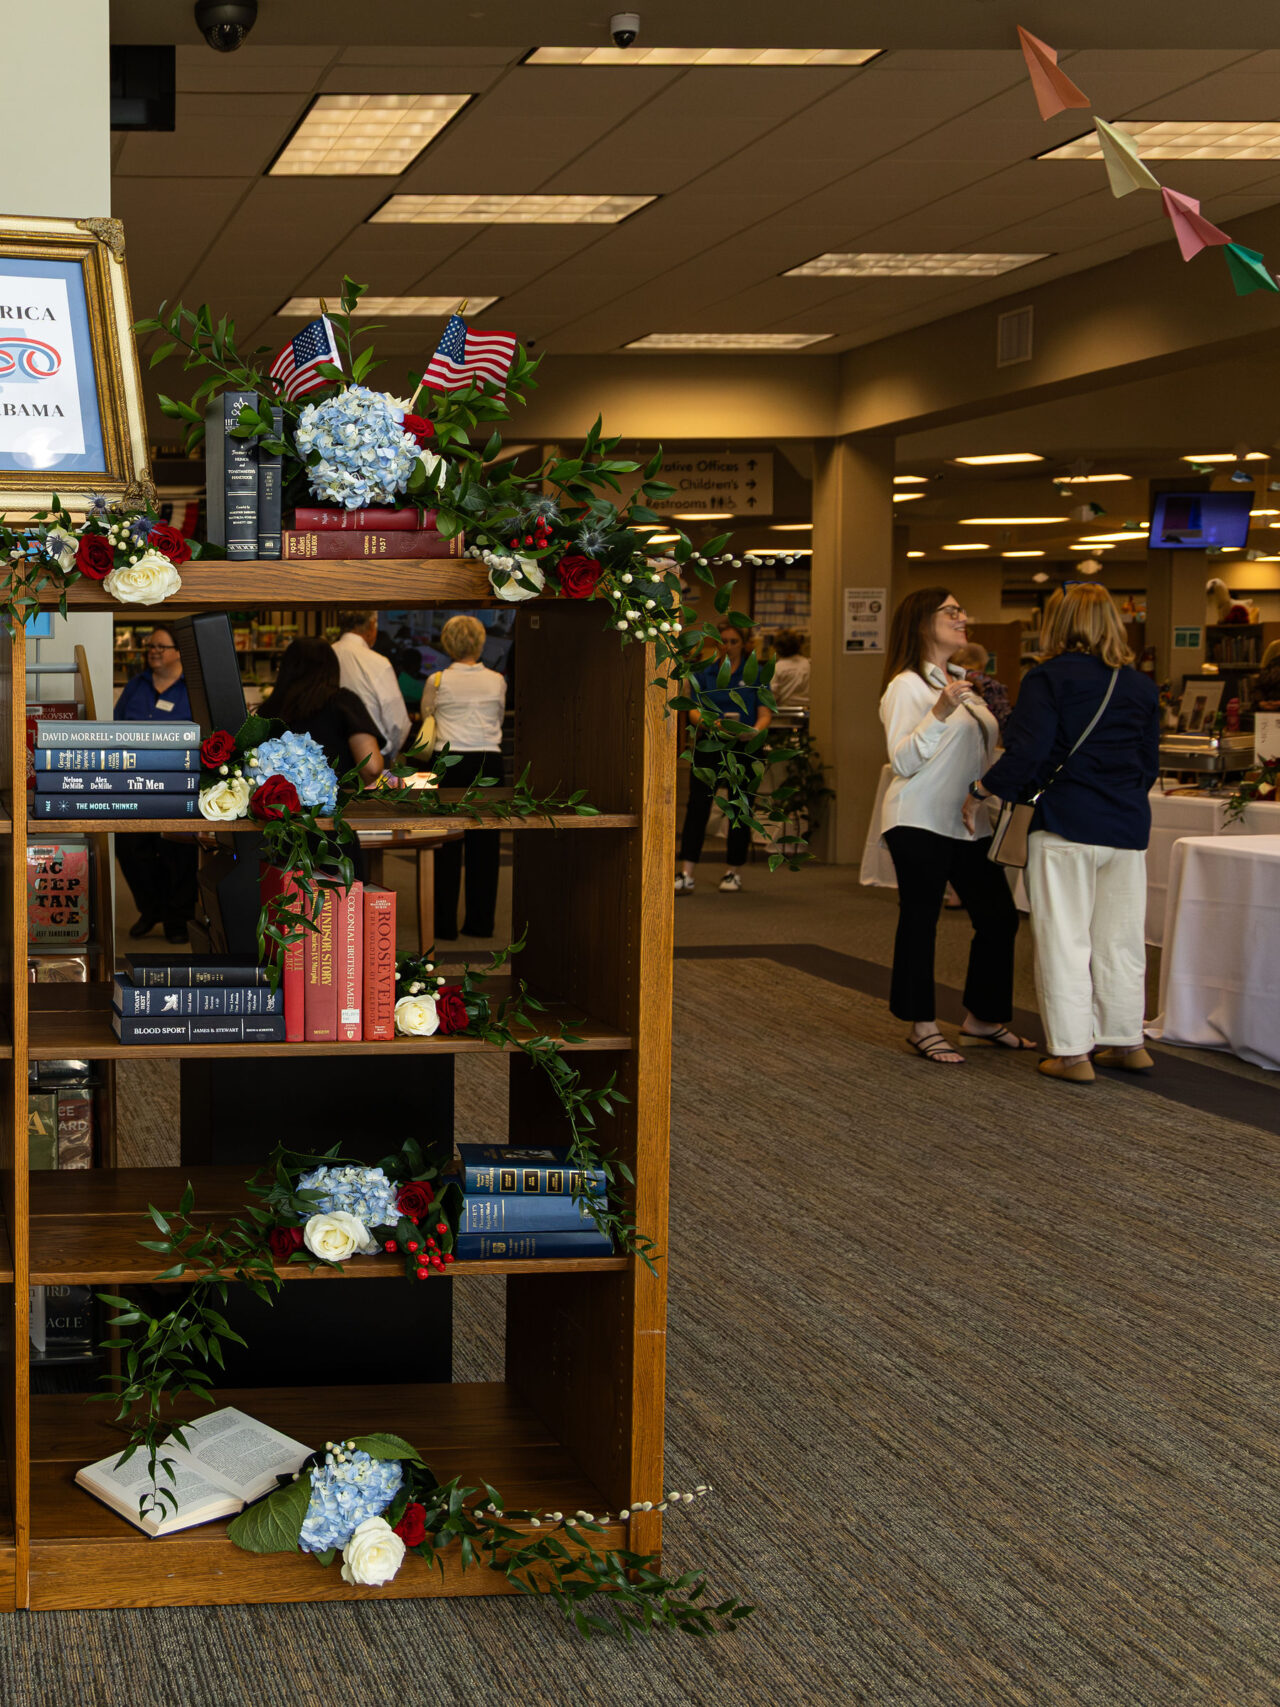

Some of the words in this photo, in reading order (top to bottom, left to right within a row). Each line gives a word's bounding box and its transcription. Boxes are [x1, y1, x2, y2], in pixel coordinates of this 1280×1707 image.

[696, 460, 739, 472] Offices
[679, 478, 739, 491] Children's
[645, 499, 707, 510] Restrooms
[42, 733, 68, 742] DAVID
[70, 733, 110, 742] MORRELL
[115, 733, 150, 742] DOUBLE
[152, 733, 180, 742] IMAGE
[127, 780, 143, 790] Tin
[145, 780, 164, 790] Men
[36, 862, 63, 874] AC
[35, 878, 80, 891] CEP
[36, 895, 79, 908] TAN
[51, 912, 80, 924] CE
[347, 896, 355, 944] COLONIAL
[322, 901, 332, 952] WINDSOR
[294, 947, 303, 971] VIII
[347, 945, 355, 979] BRITISH
[322, 954, 332, 986] STORY
[377, 911, 391, 1024] ROOSEVELT
[134, 1027, 161, 1035] BLOOD
